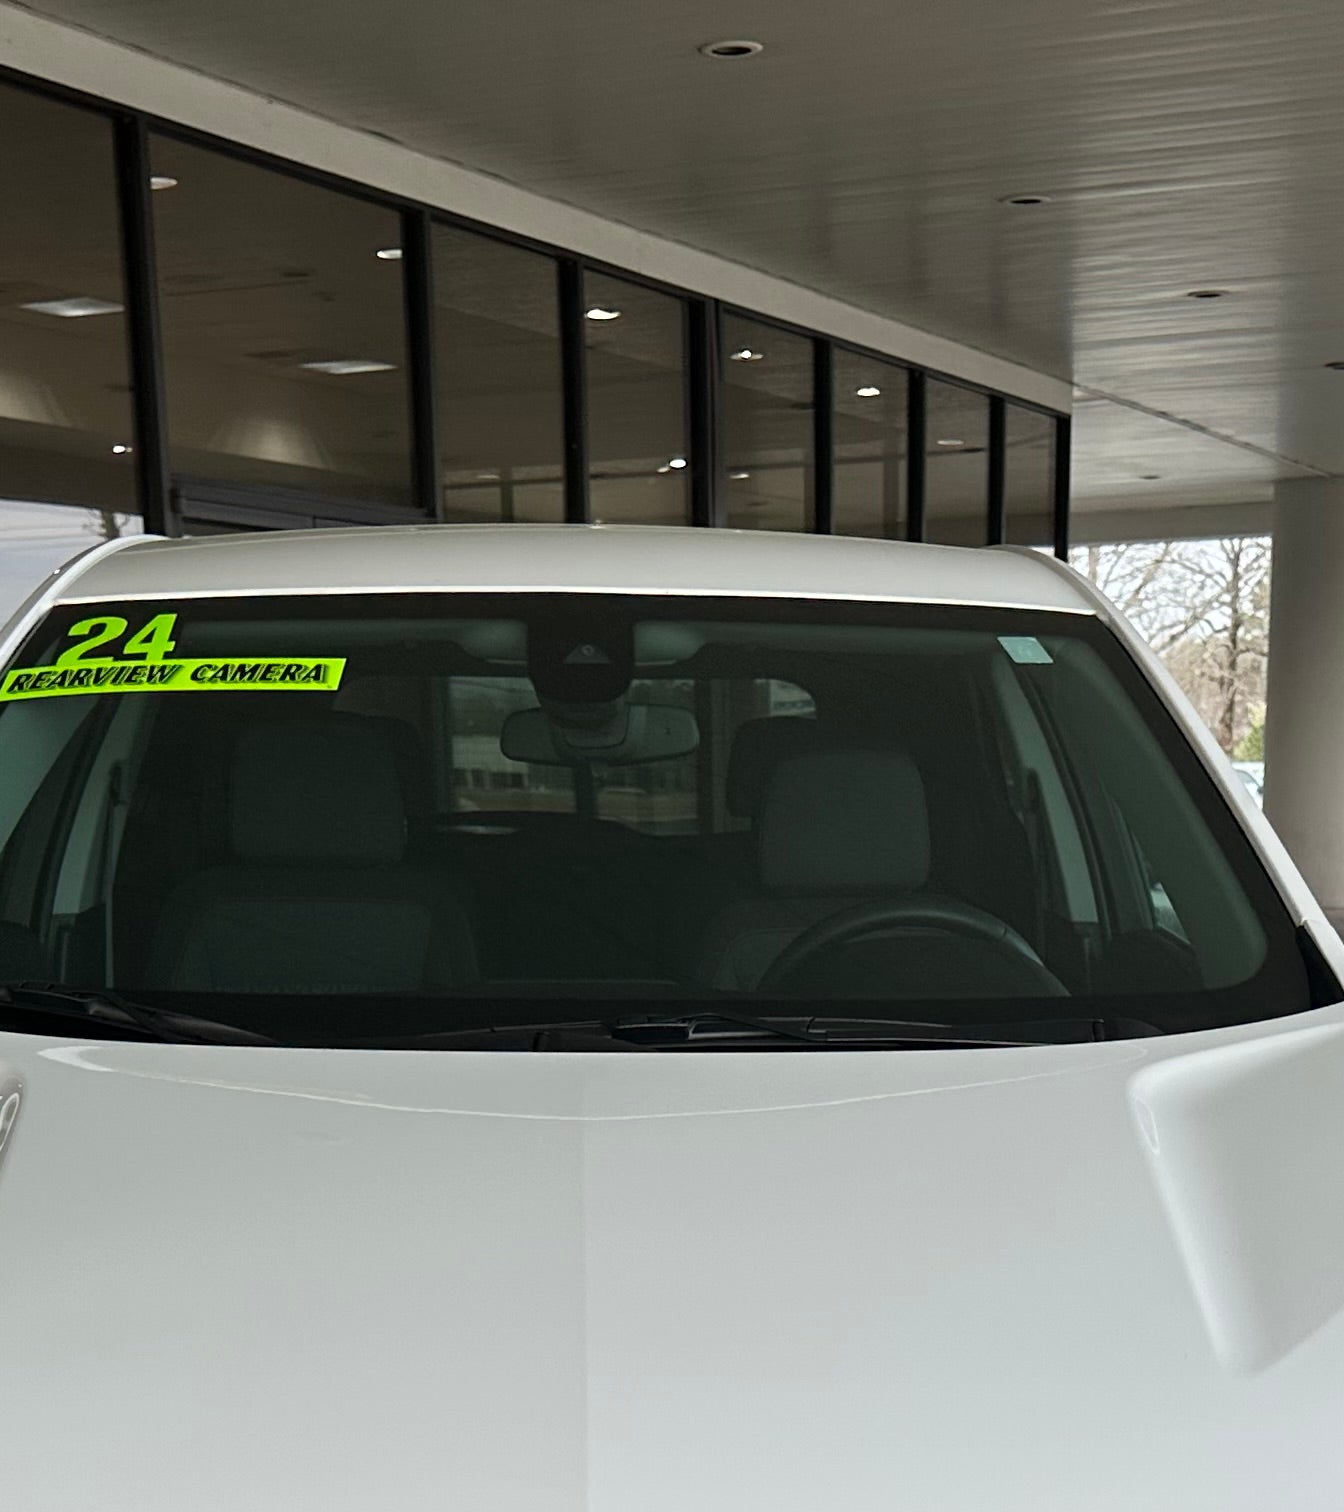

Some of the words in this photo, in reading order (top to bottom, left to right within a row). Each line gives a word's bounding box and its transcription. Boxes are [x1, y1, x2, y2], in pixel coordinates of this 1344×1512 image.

[56, 613, 178, 666] 24
[6, 663, 183, 694] REARVIEW
[190, 662, 327, 684] CAMERA
